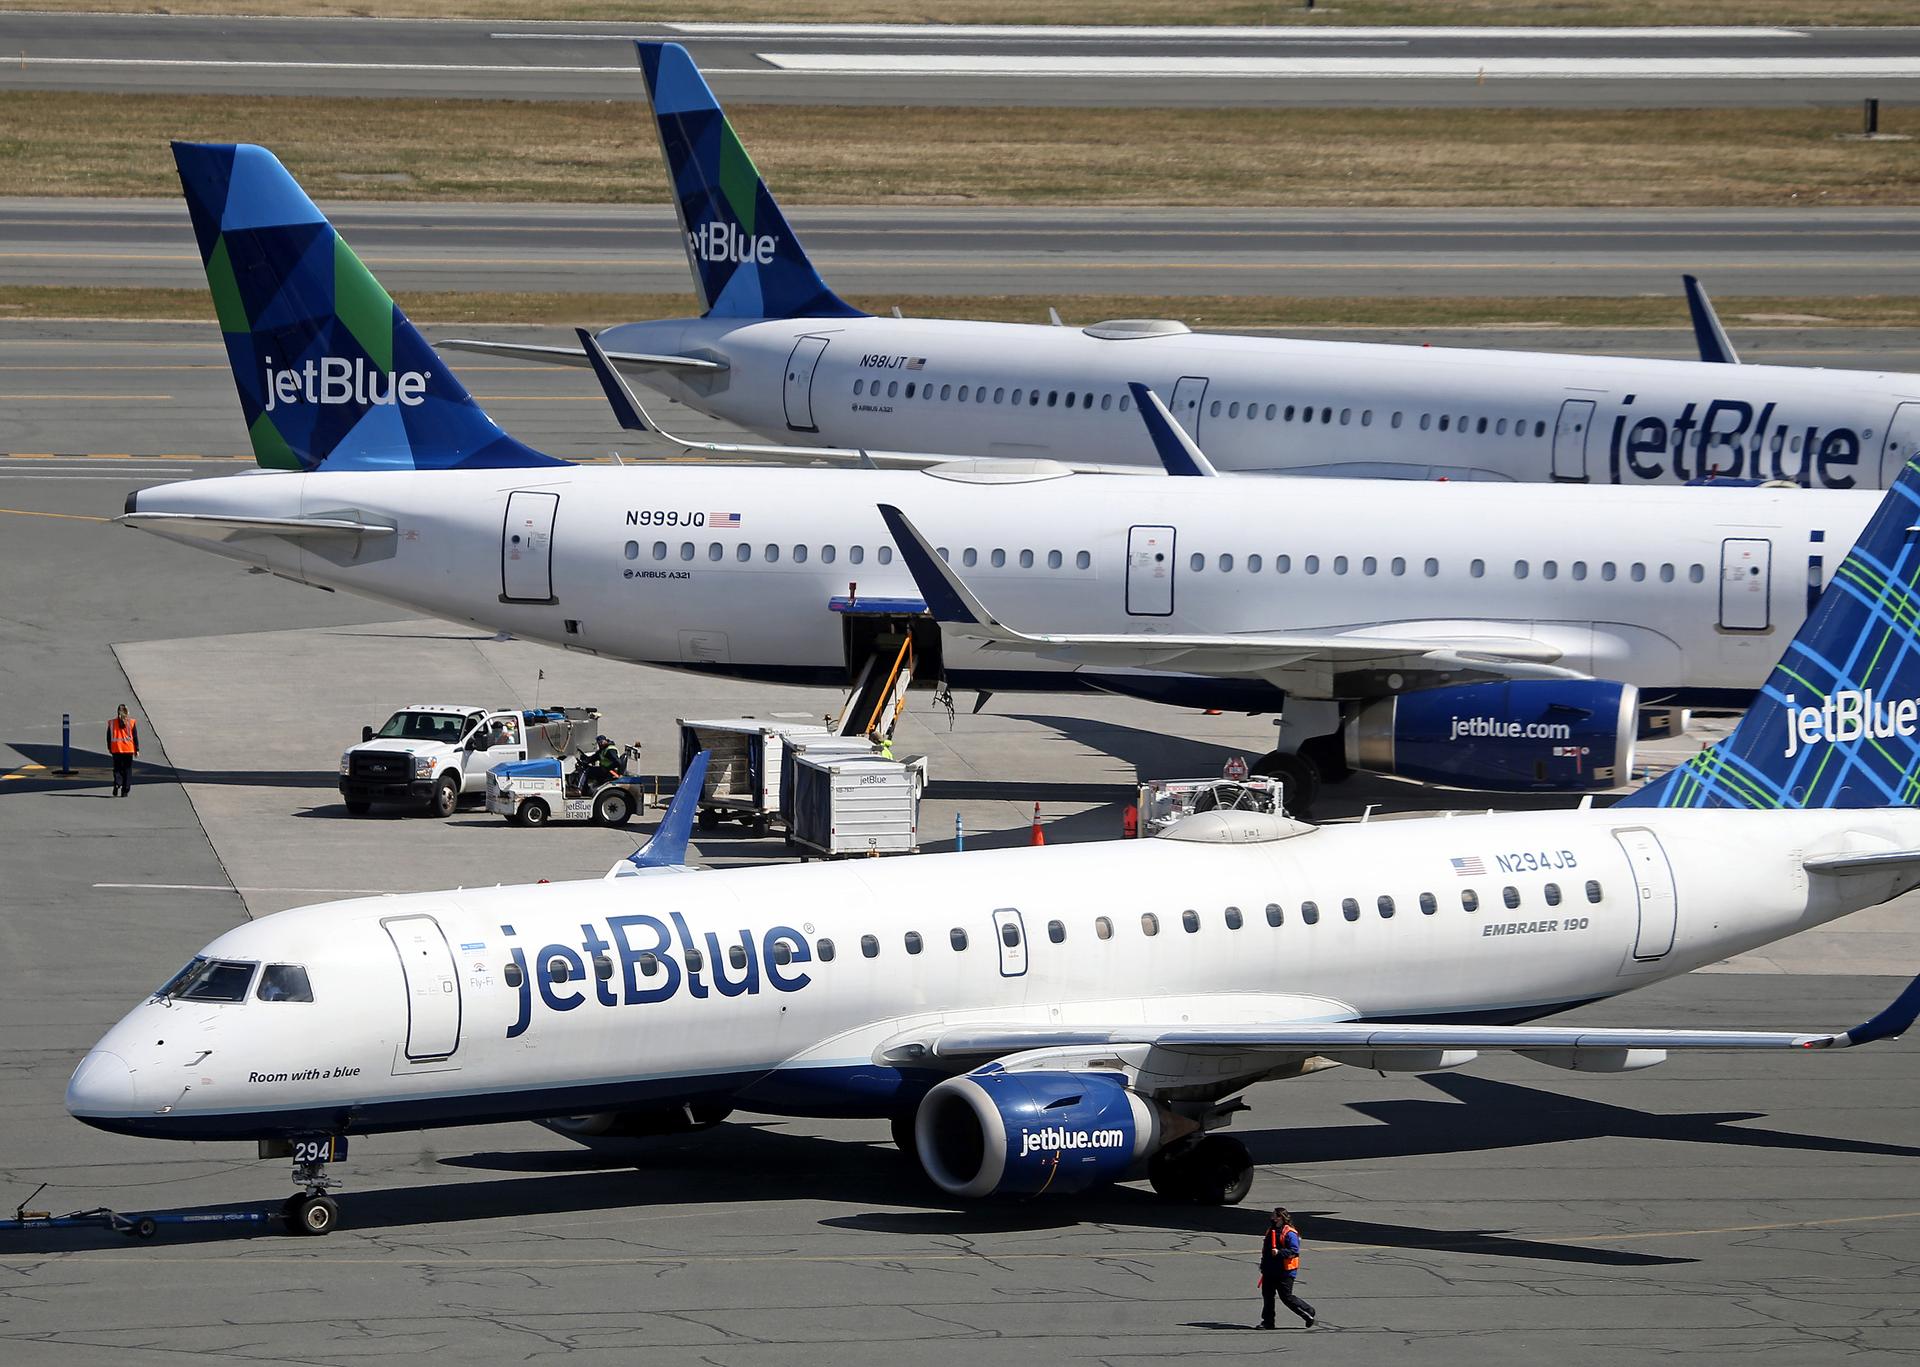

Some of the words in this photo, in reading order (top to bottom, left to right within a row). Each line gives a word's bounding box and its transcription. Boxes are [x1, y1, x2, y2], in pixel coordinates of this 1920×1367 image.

[688, 222, 775, 264] etBlue
[860, 354, 907, 369] N981JT
[265, 356, 426, 411] jetBlue
[858, 404, 878, 412] AIRBUS
[1609, 394, 1860, 489] jetBlue
[626, 511, 705, 527] N999JQ
[1450, 716, 1570, 740] jetblue.com
[1785, 688, 1918, 758] jetBlue
[860, 775, 887, 785] jetBlue
[565, 802, 592, 811] jetBlue
[1496, 850, 1577, 873] N294JB
[1482, 920, 1558, 937] EMBRAER
[1563, 917, 1589, 931] 190
[470, 976, 495, 989] Fly-Fi
[500, 912, 811, 1038] jetBlue
[248, 1071, 287, 1082] Room
[291, 1068, 320, 1081] with
[322, 1070, 330, 1078] a
[333, 1066, 360, 1078] blue
[294, 1141, 330, 1162] 294
[1020, 1127, 1123, 1157] jetblue.com
